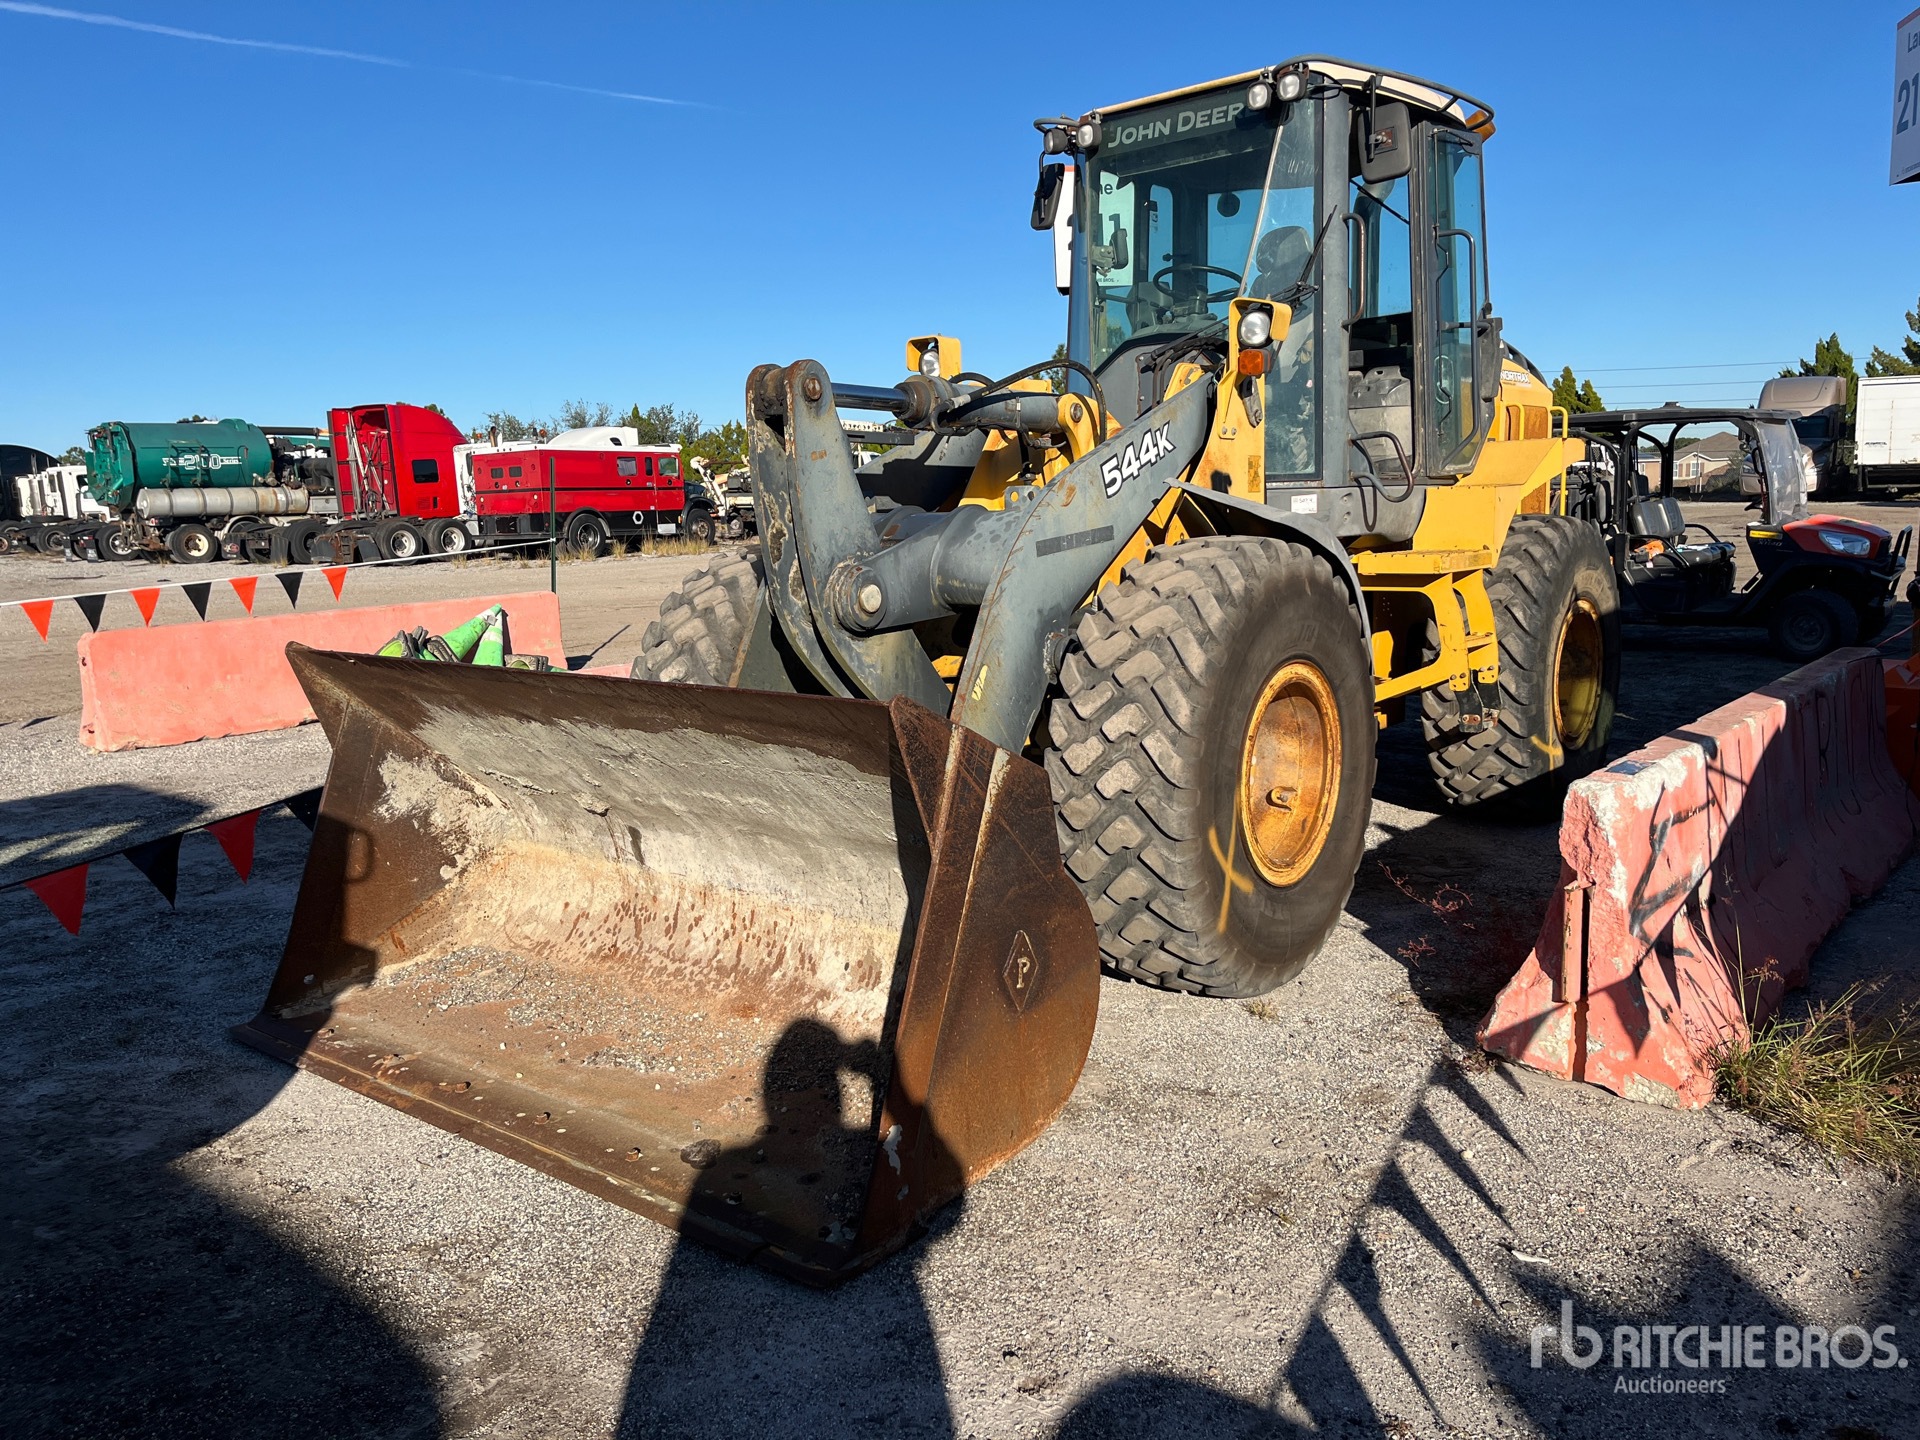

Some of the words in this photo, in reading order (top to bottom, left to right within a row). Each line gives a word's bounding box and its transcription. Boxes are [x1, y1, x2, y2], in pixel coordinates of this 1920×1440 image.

[1107, 119, 1171, 148] JOHN
[1177, 102, 1245, 132] DEER
[1101, 421, 1176, 498] 544K
